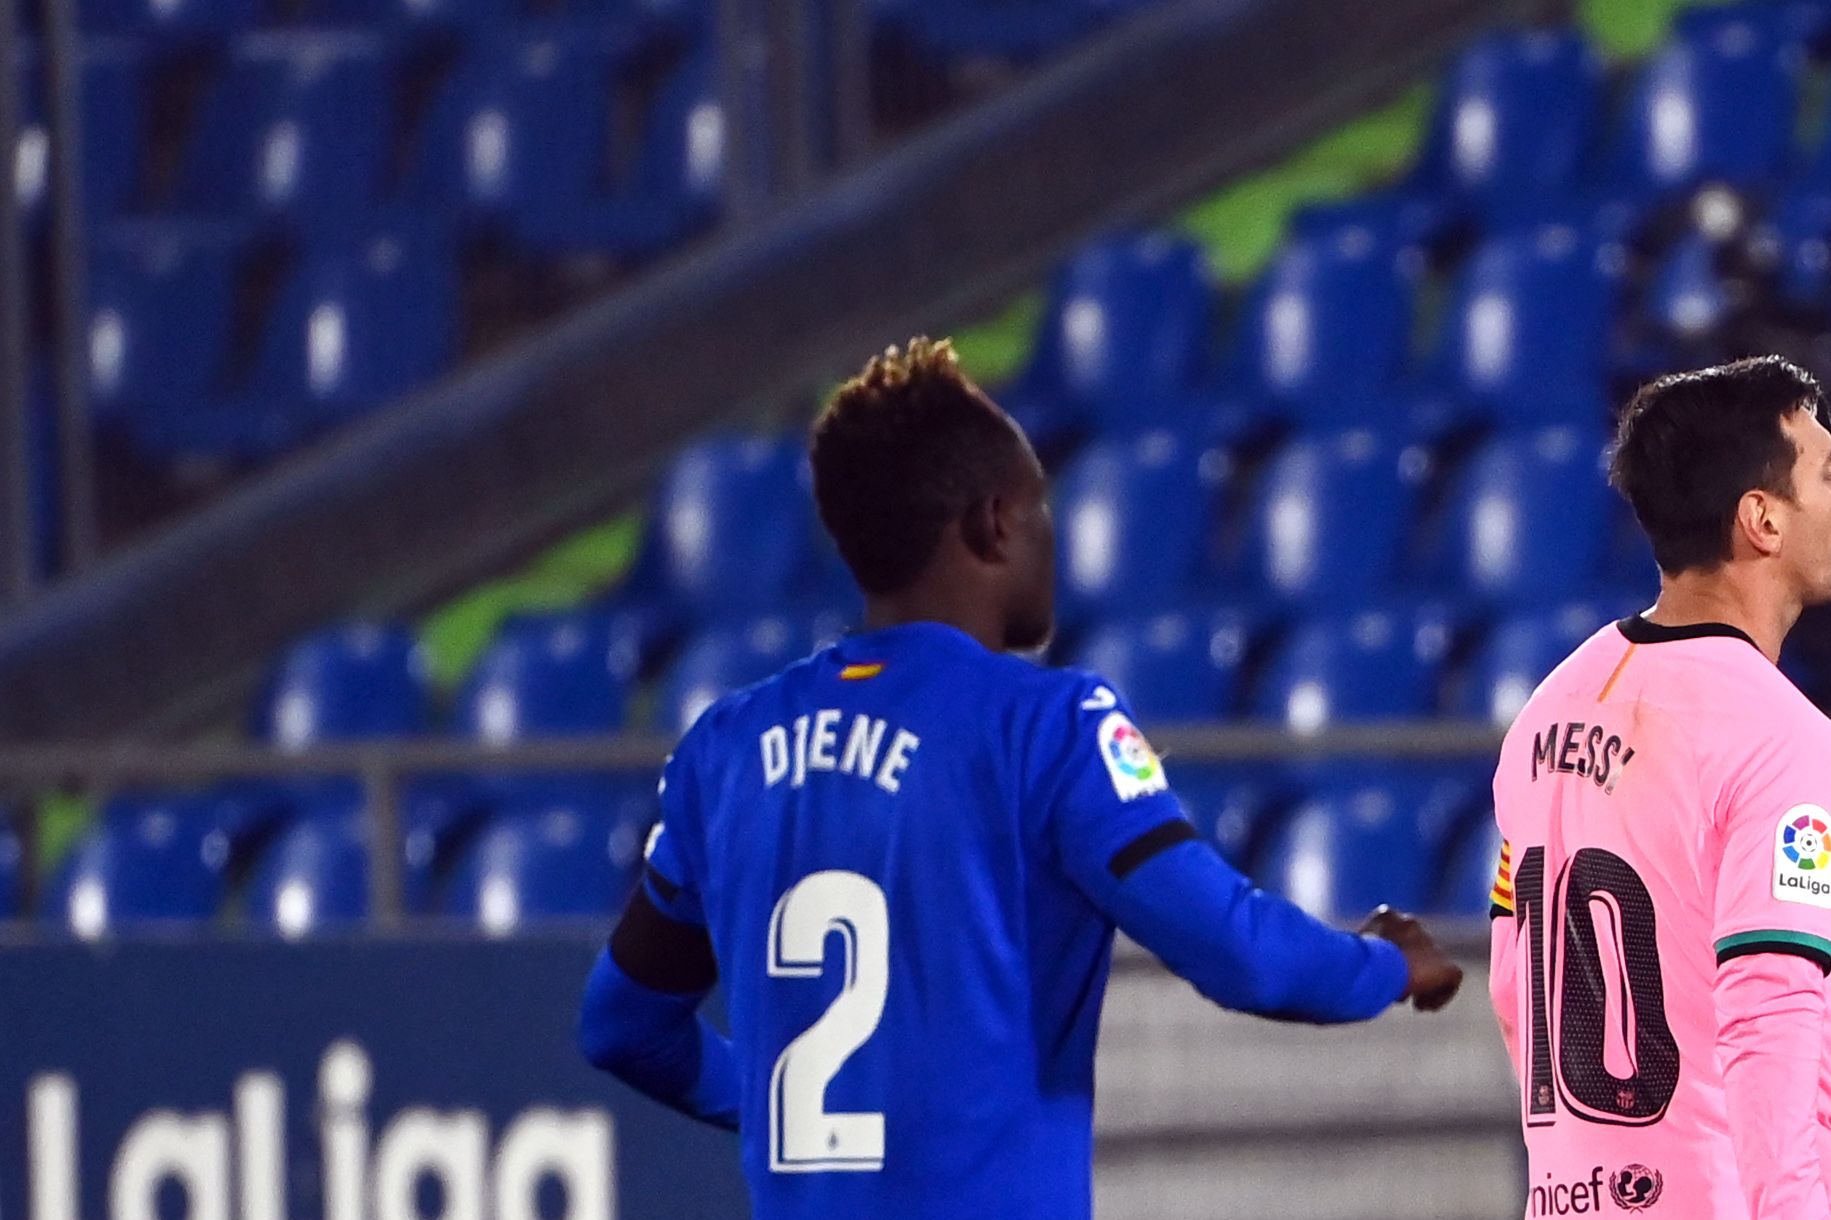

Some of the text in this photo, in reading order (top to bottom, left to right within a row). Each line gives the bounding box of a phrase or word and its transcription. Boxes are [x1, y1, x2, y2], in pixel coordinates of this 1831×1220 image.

[760, 708, 921, 794] DJENE
[1779, 873, 1831, 895] LaLiga
[766, 869, 890, 1173] 2
[1515, 845, 1681, 1128] 10
